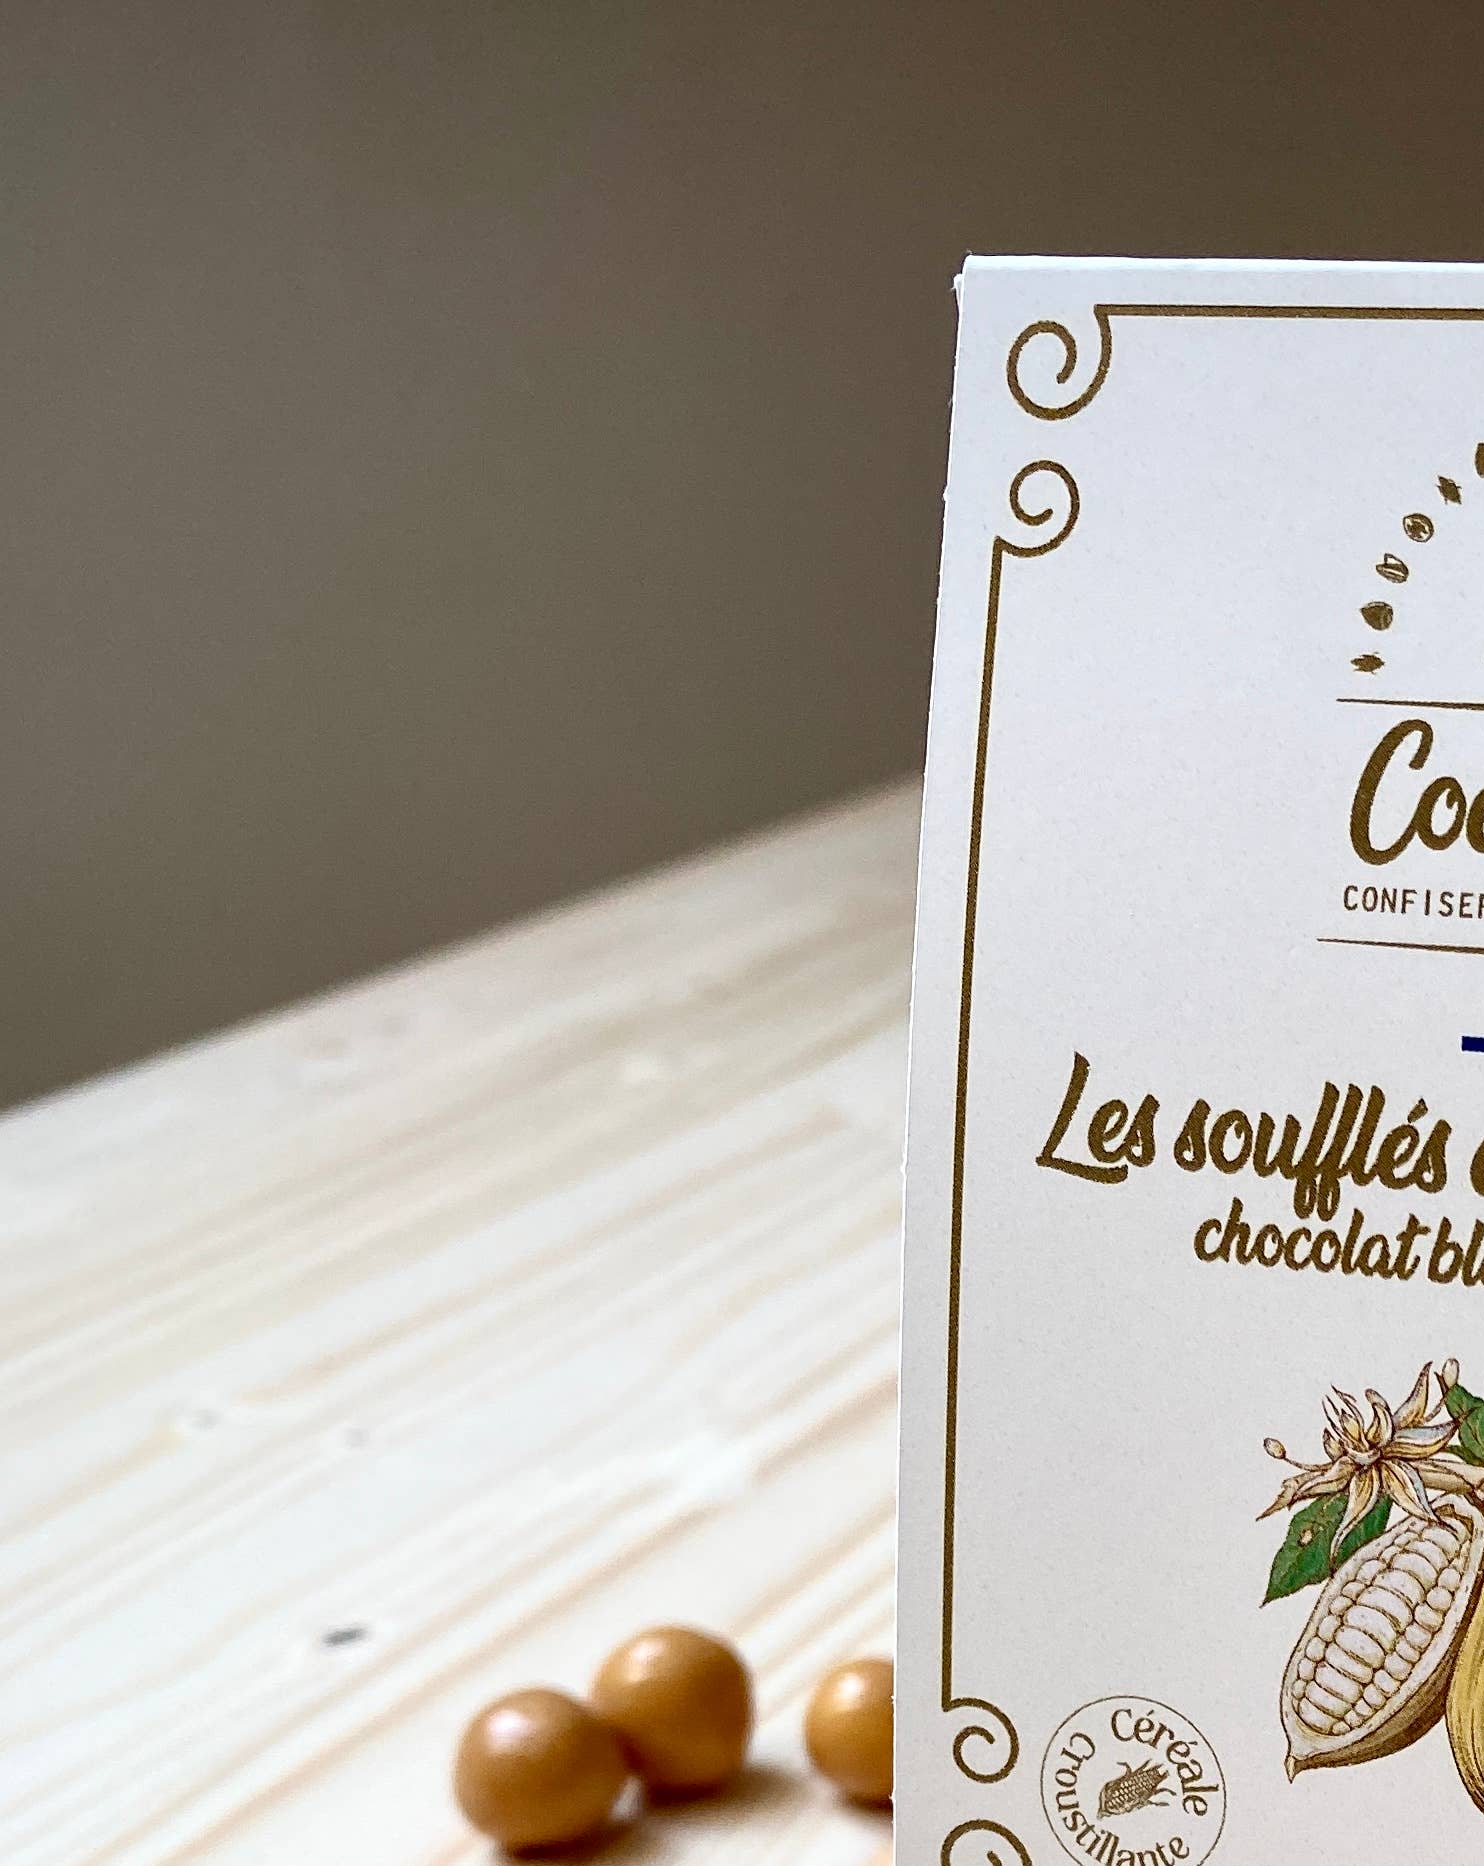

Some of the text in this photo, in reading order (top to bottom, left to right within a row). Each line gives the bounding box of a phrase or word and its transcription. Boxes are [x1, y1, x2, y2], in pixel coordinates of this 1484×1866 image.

[1036, 1052, 1161, 1184] Les
[1173, 1082, 1453, 1222] soufflés
[1194, 1197, 1431, 1281] chocolat
[1111, 1709, 1219, 1817] Céréale
